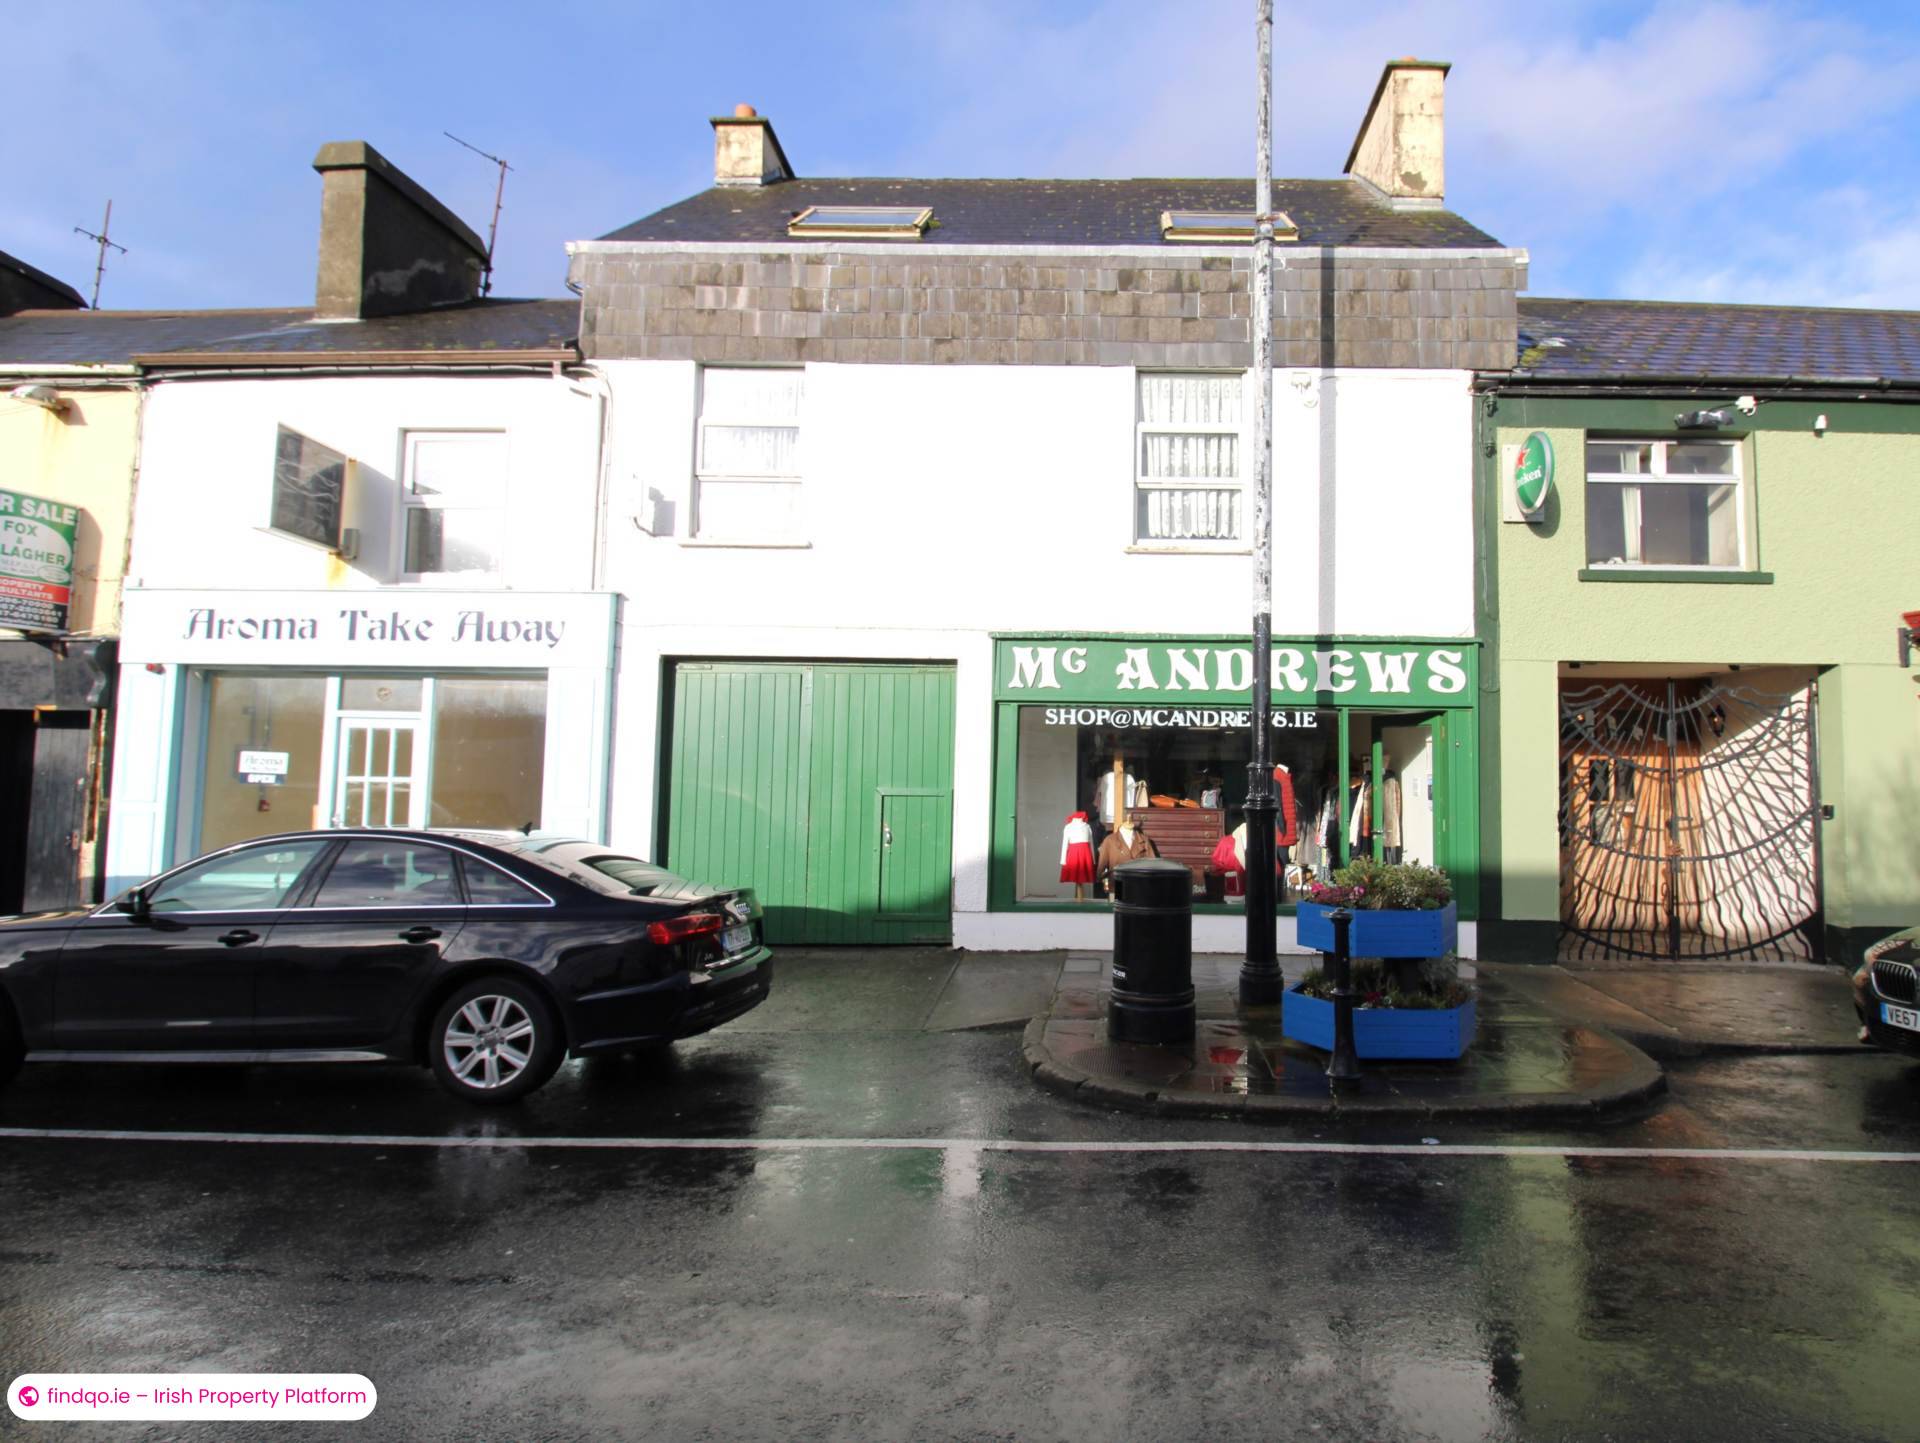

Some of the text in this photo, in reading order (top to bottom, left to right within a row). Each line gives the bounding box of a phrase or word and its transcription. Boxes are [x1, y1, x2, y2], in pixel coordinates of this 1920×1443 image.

[21, 499, 76, 526] SALE
[4, 520, 37, 537] FOX
[0, 544, 65, 566] LAGHER
[184, 608, 565, 648] Aroma Take Away
[1115, 647, 1467, 694] ANDREWS
[1045, 708, 1317, 728] SHOP@MCANDRES.IE
[1888, 1007, 1918, 1027] VE67
